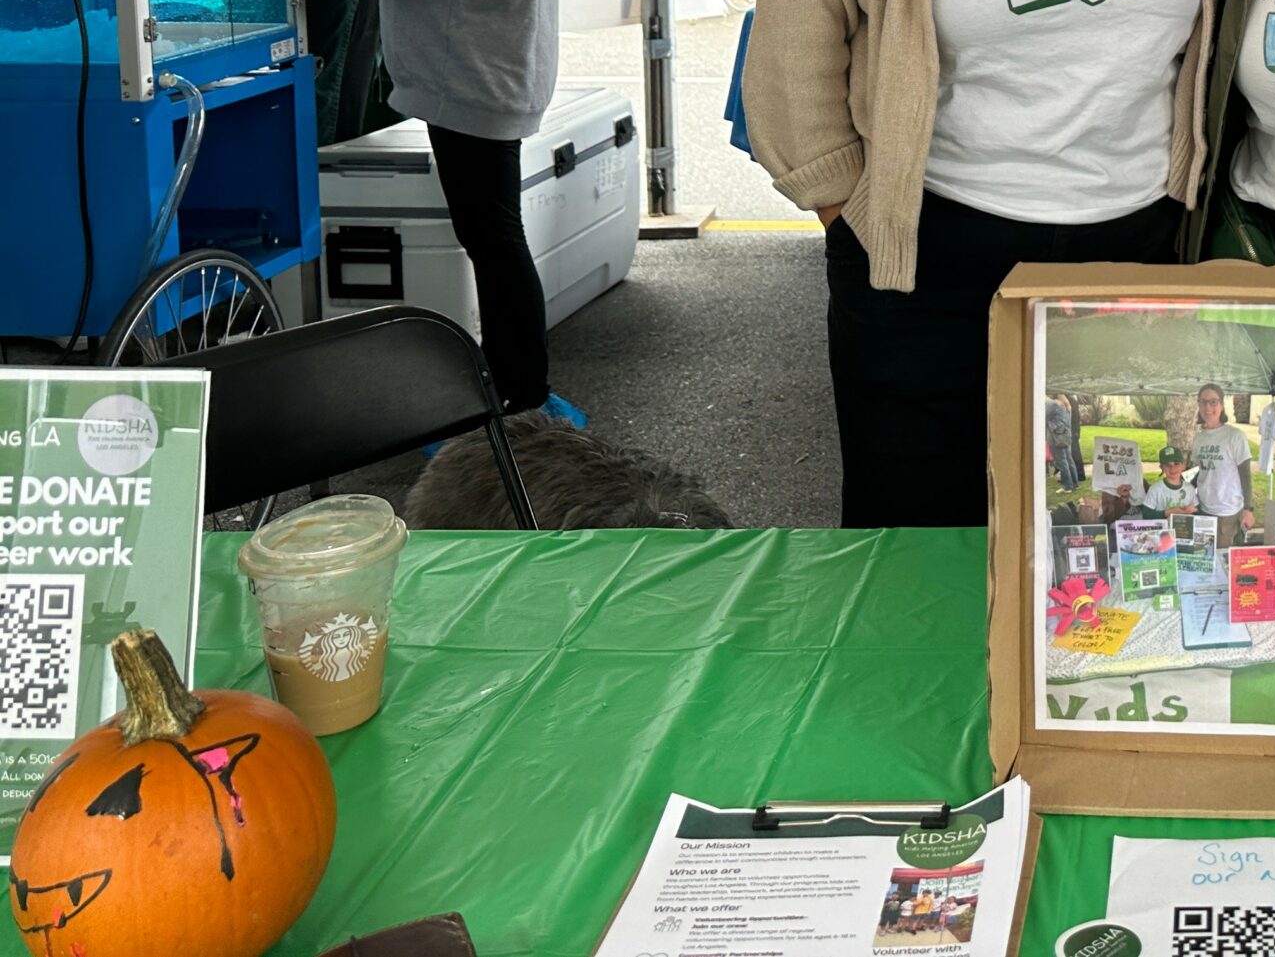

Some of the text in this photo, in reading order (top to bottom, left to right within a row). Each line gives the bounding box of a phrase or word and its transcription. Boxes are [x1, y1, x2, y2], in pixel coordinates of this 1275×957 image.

[30, 426, 61, 447] LA
[84, 418, 153, 434] KIDSHA
[20, 476, 153, 506] DONATE
[0, 510, 125, 541] port our
[48, 535, 133, 566] work
[903, 823, 987, 845] KIDSHA
[680, 842, 702, 850] Our
[1197, 843, 1262, 872] Sign
[669, 868, 697, 876] Who
[654, 905, 687, 913] What
[711, 904, 742, 913] offer
[872, 945, 962, 956] Volunteer with
